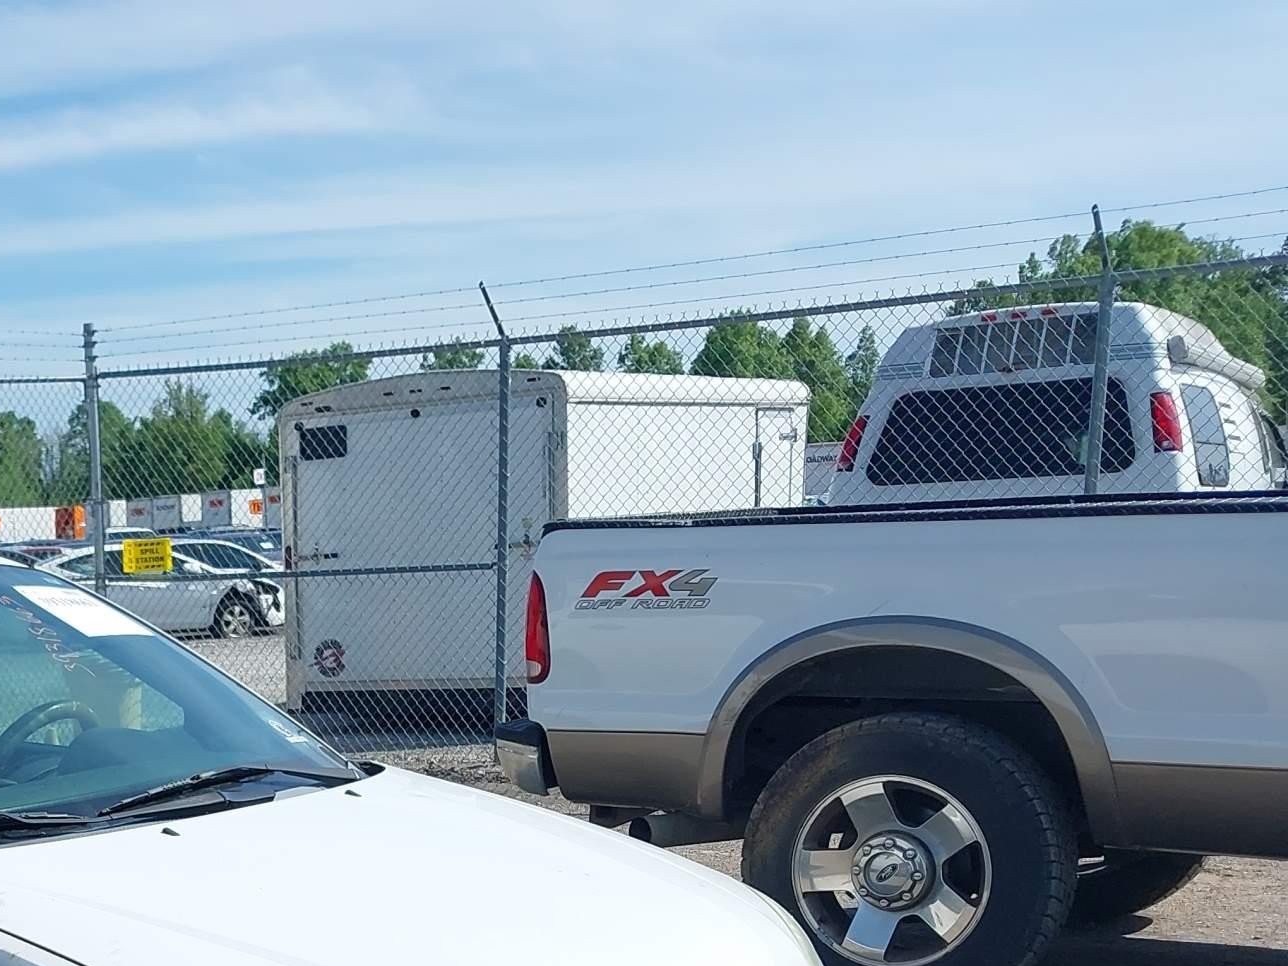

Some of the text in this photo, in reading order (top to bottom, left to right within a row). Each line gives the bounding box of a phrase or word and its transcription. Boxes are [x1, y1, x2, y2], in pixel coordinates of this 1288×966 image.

[806, 455, 838, 463] OADWAY
[135, 556, 165, 564] STATION
[580, 569, 719, 598] FX4
[575, 598, 711, 610] OFF ROAD
